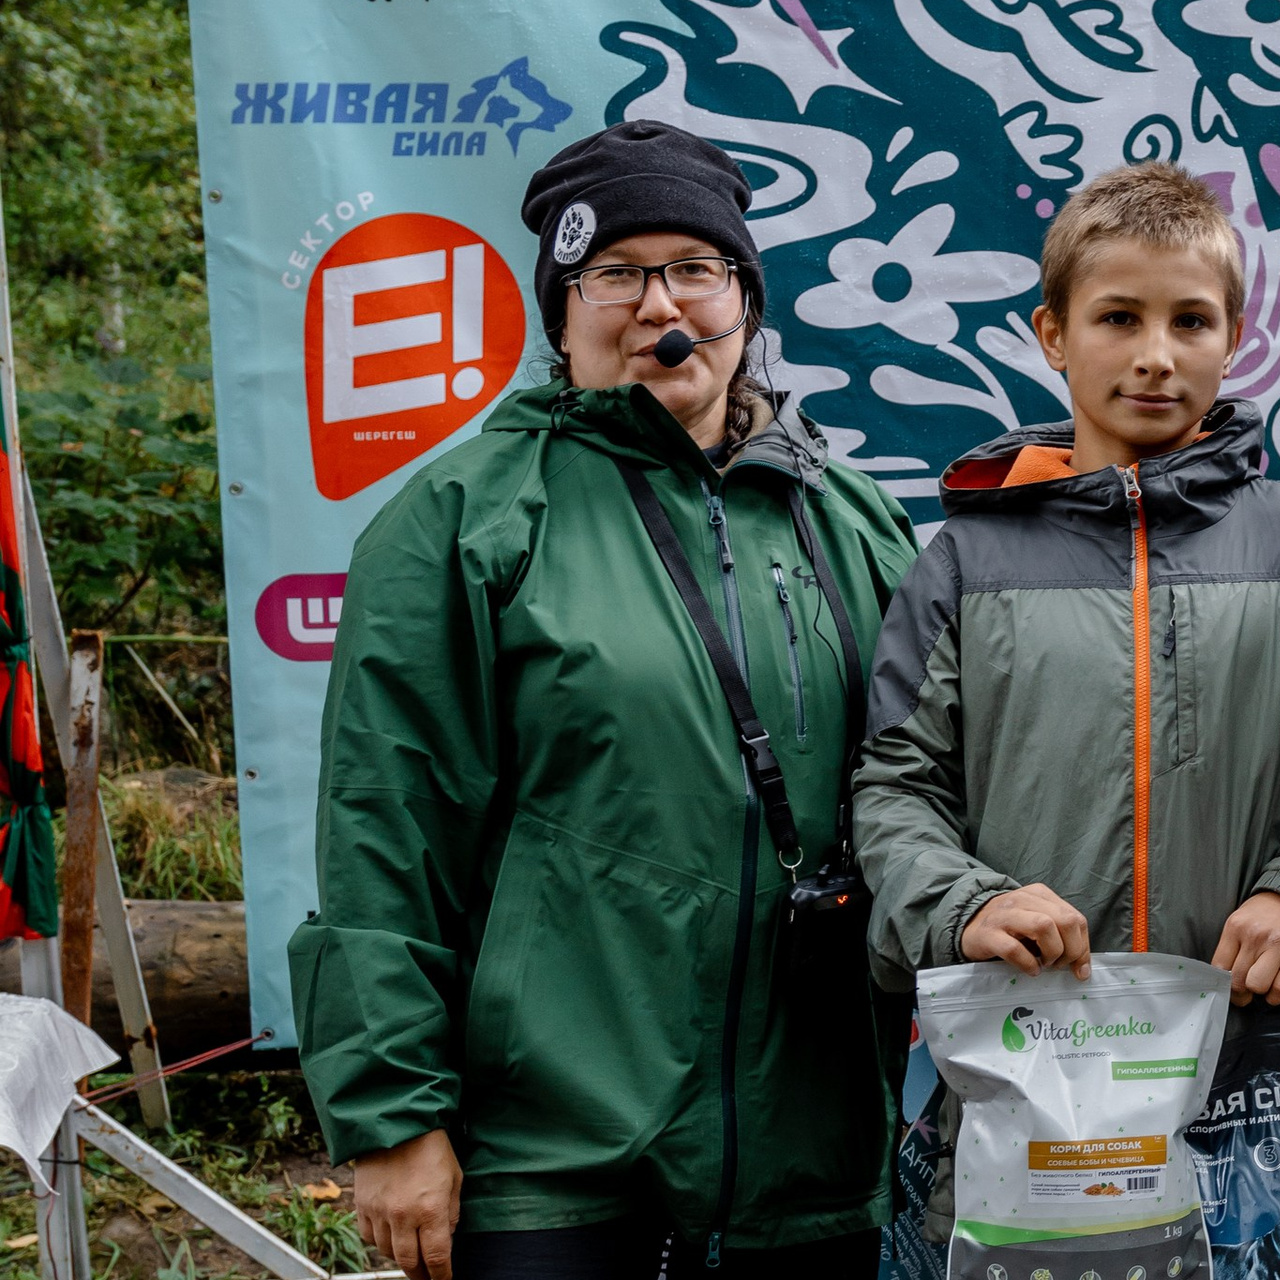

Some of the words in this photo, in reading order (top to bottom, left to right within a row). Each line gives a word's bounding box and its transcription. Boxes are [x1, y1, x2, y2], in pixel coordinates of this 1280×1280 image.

[231, 82, 450, 125] ЖИВАЯ
[392, 131, 486, 156] СИЛА
[281, 190, 376, 291] СЕКТОР
[353, 430, 416, 442] ШЕРЕГЕШ
[1026, 1016, 1156, 1047] VitaGreenka
[1117, 1063, 1195, 1075] ГИПОАЛЛЕРГЕННЫЙ
[1200, 1091, 1246, 1120] ВАЯ
[1190, 1117, 1247, 1135] СПОРТИВНЫХ
[1050, 1144, 1080, 1154] КОРМ
[1082, 1143, 1105, 1154] ДЛЯ
[1107, 1140, 1142, 1151] СОБАК
[1264, 1145, 1278, 1163] 3
[901, 1142, 936, 1190] ДИП
[1047, 1159, 1077, 1167] СОЕВЫЕ
[1079, 1158, 1099, 1166] БОБЫ
[1107, 1155, 1145, 1165] ЧЕЧЕВИЦА
[1098, 1167, 1161, 1177] ГИПОАЛЛЕРГЕННЫЙ
[1164, 1226, 1172, 1238] 1
[1173, 1225, 1183, 1238] kg
